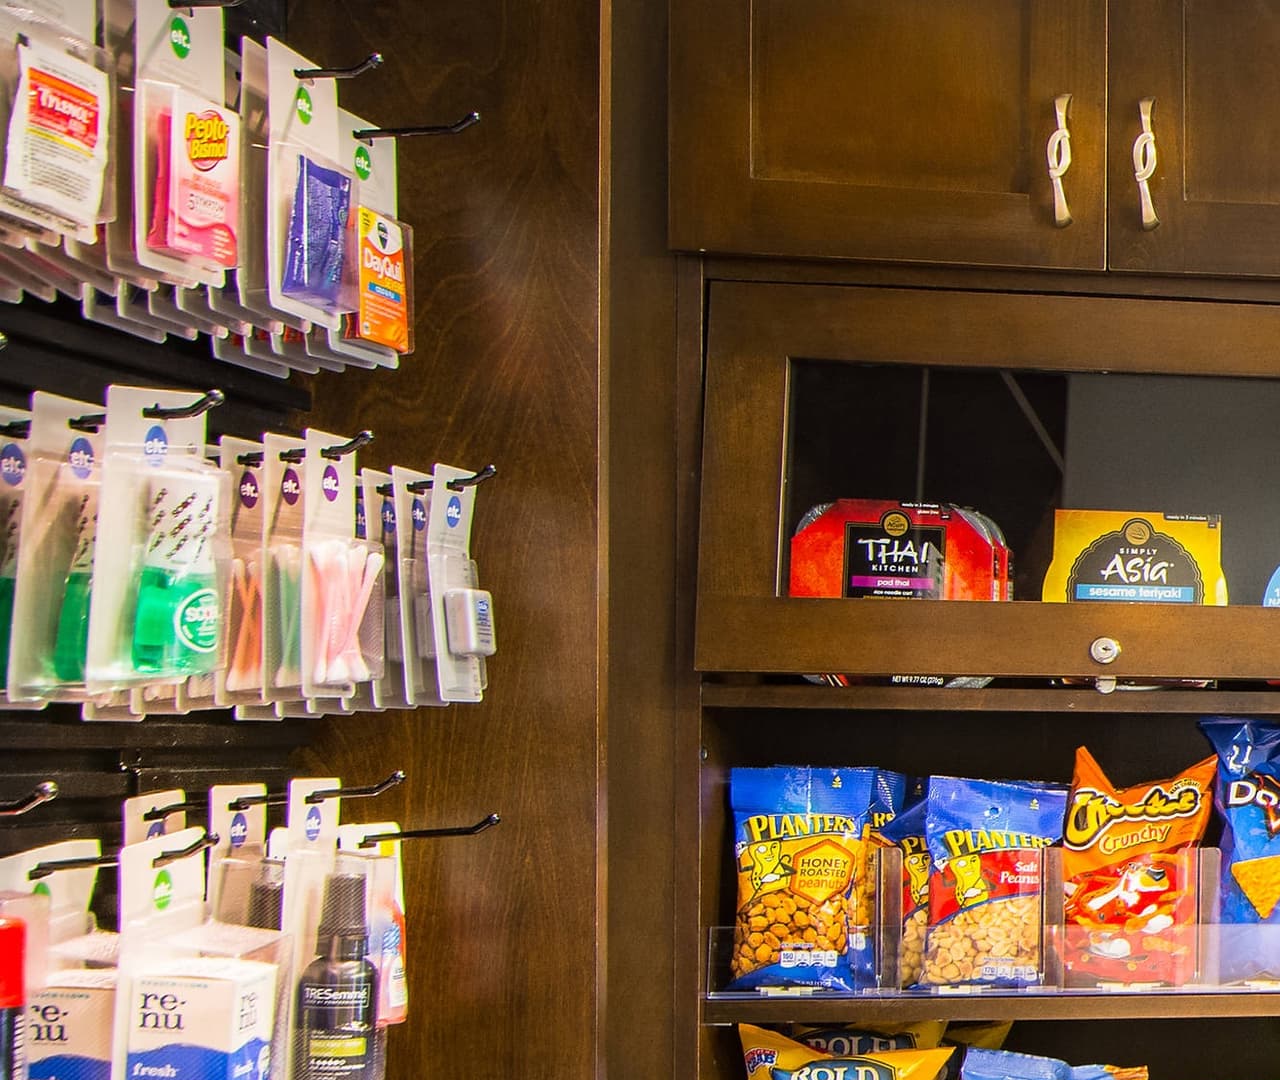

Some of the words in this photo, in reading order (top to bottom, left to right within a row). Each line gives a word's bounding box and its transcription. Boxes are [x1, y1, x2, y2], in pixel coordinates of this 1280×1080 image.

[191, 139, 228, 158] Bismol
[858, 538, 929, 564] THAI
[1101, 554, 1168, 584] Asia
[1089, 588, 1136, 597] sesame
[1139, 588, 1181, 599] teriyaki
[748, 814, 855, 841] PLANTERS
[1100, 823, 1171, 854] Crunchy
[945, 830, 1053, 858] PLANTERS
[800, 858, 849, 869] HONEY
[800, 867, 846, 878] ROASTED
[139, 1012, 184, 1030] nu
